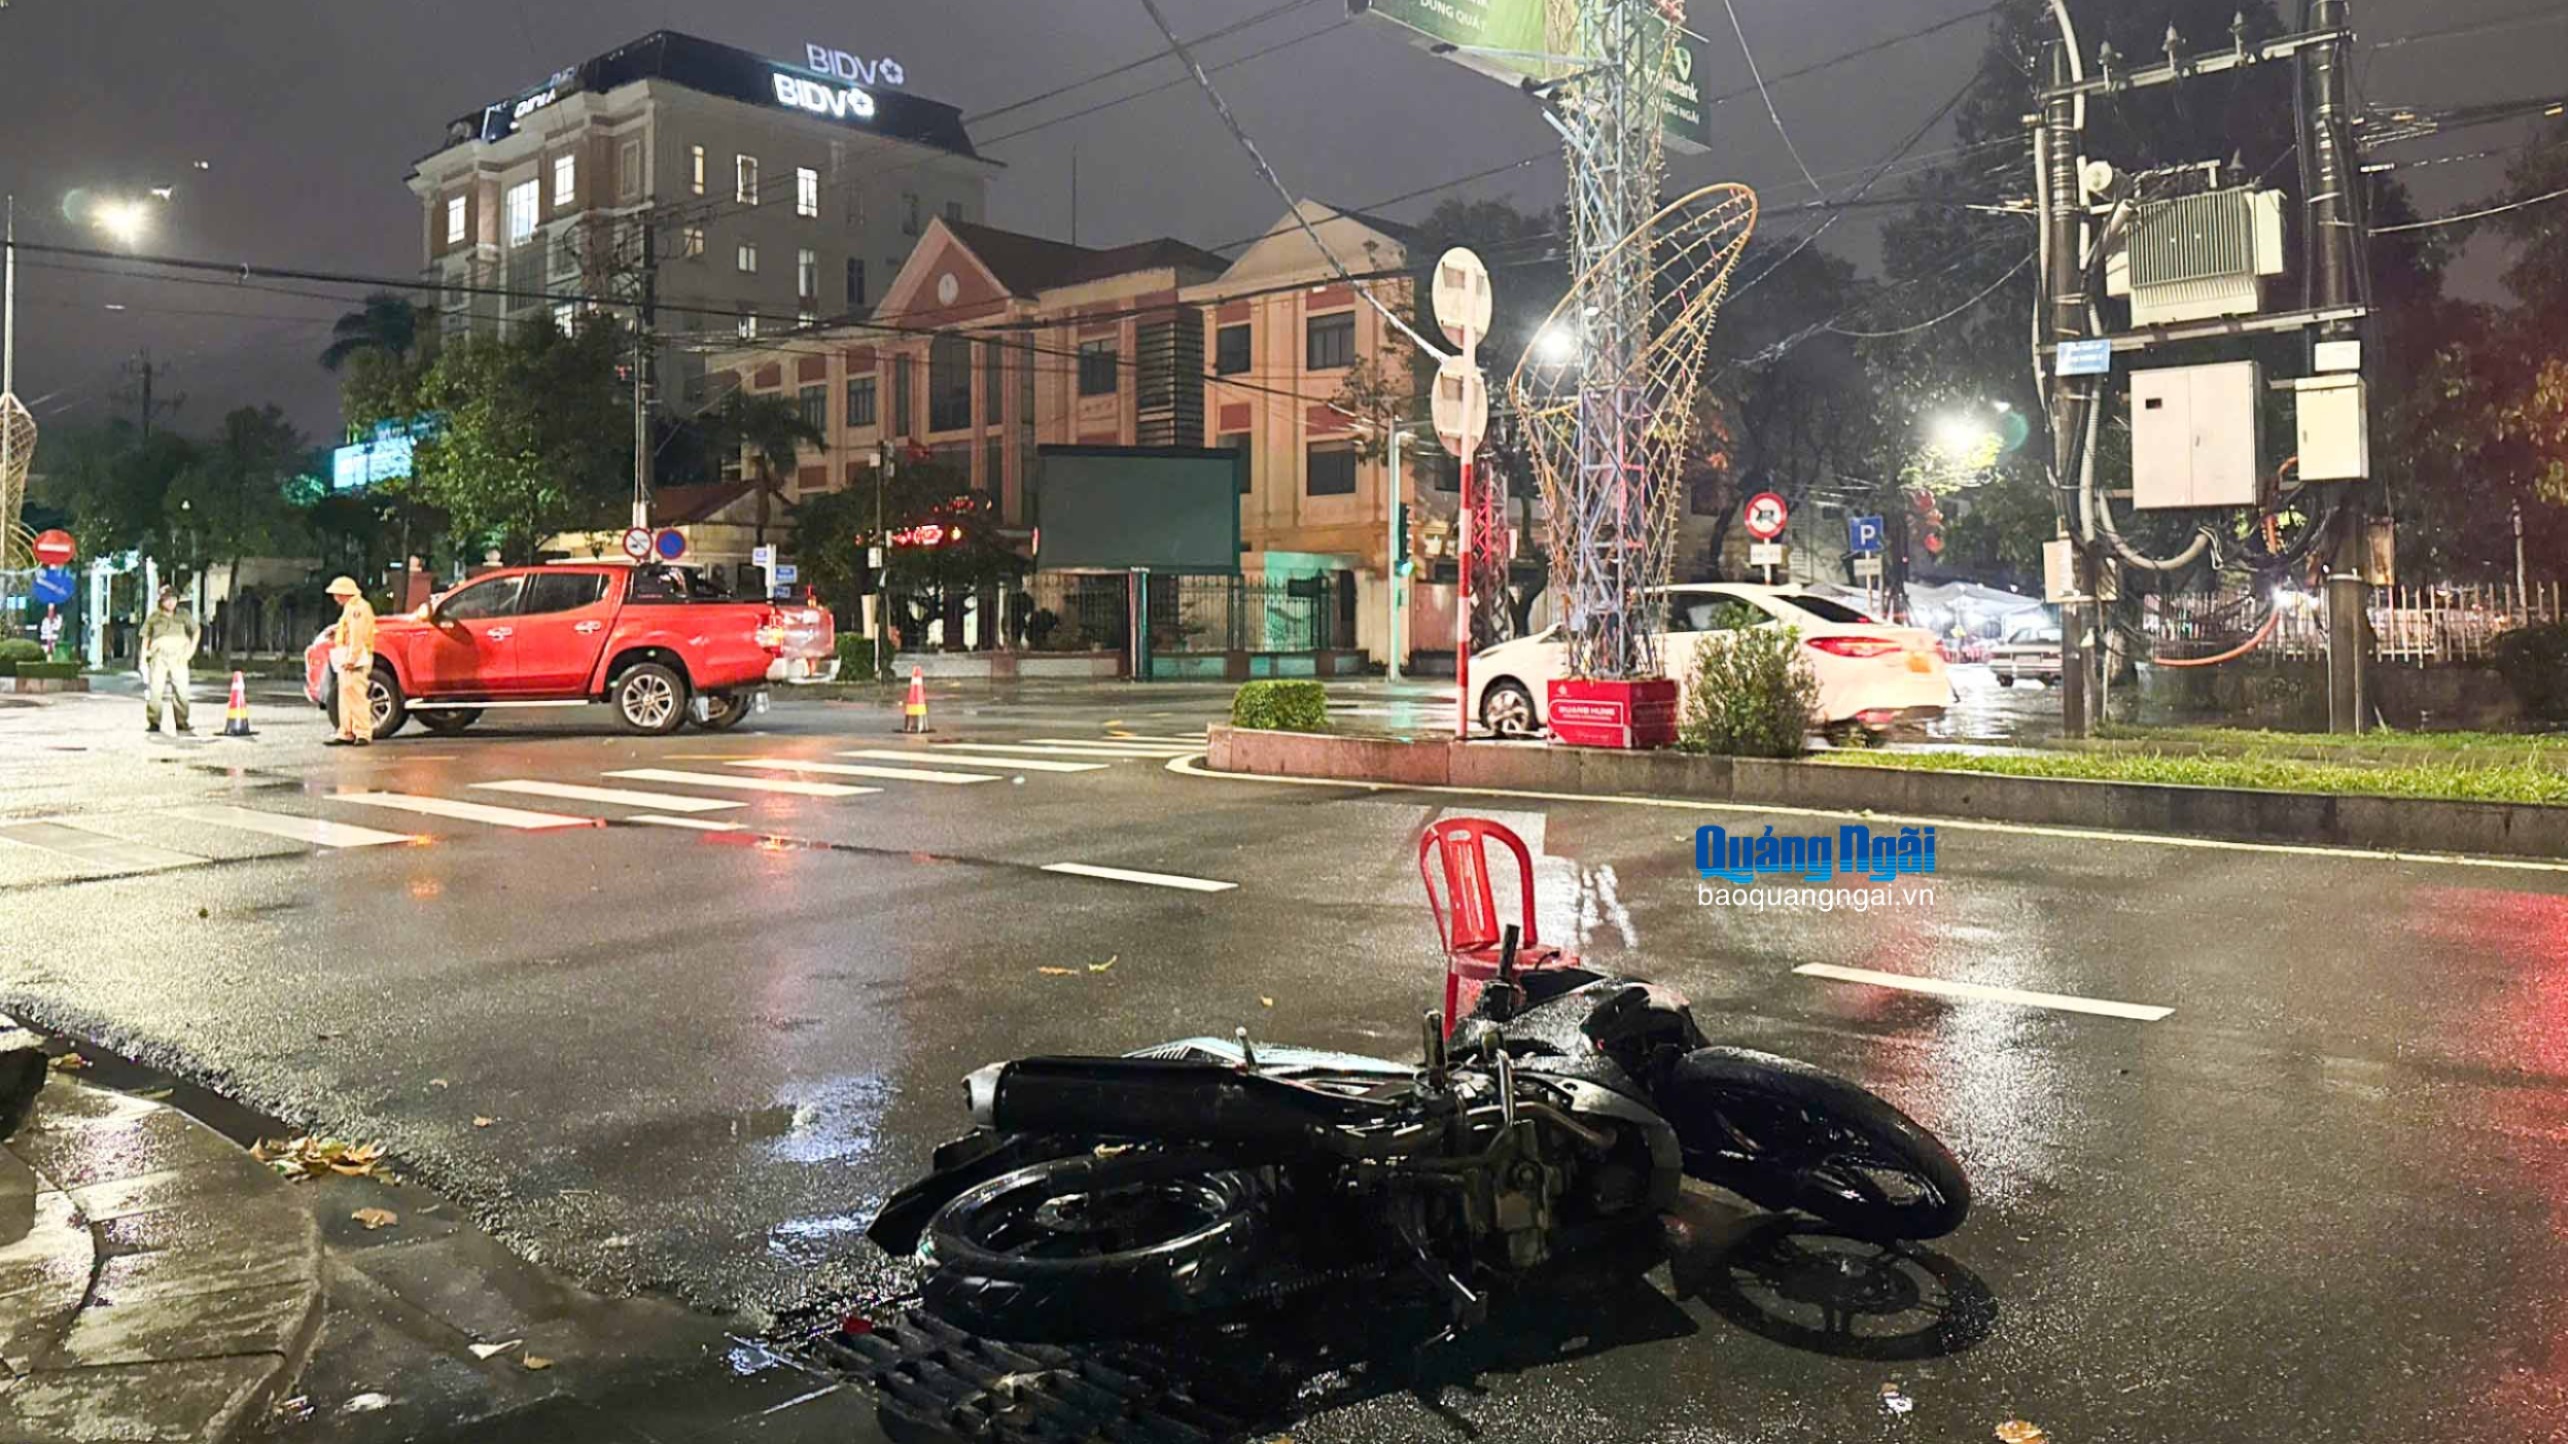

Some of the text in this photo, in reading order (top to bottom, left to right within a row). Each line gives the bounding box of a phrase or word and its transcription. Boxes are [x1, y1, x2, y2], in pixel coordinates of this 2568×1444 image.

[806, 43, 878, 85] BIDV
[773, 72, 848, 117] BIDV
[1860, 524, 1876, 546] P
